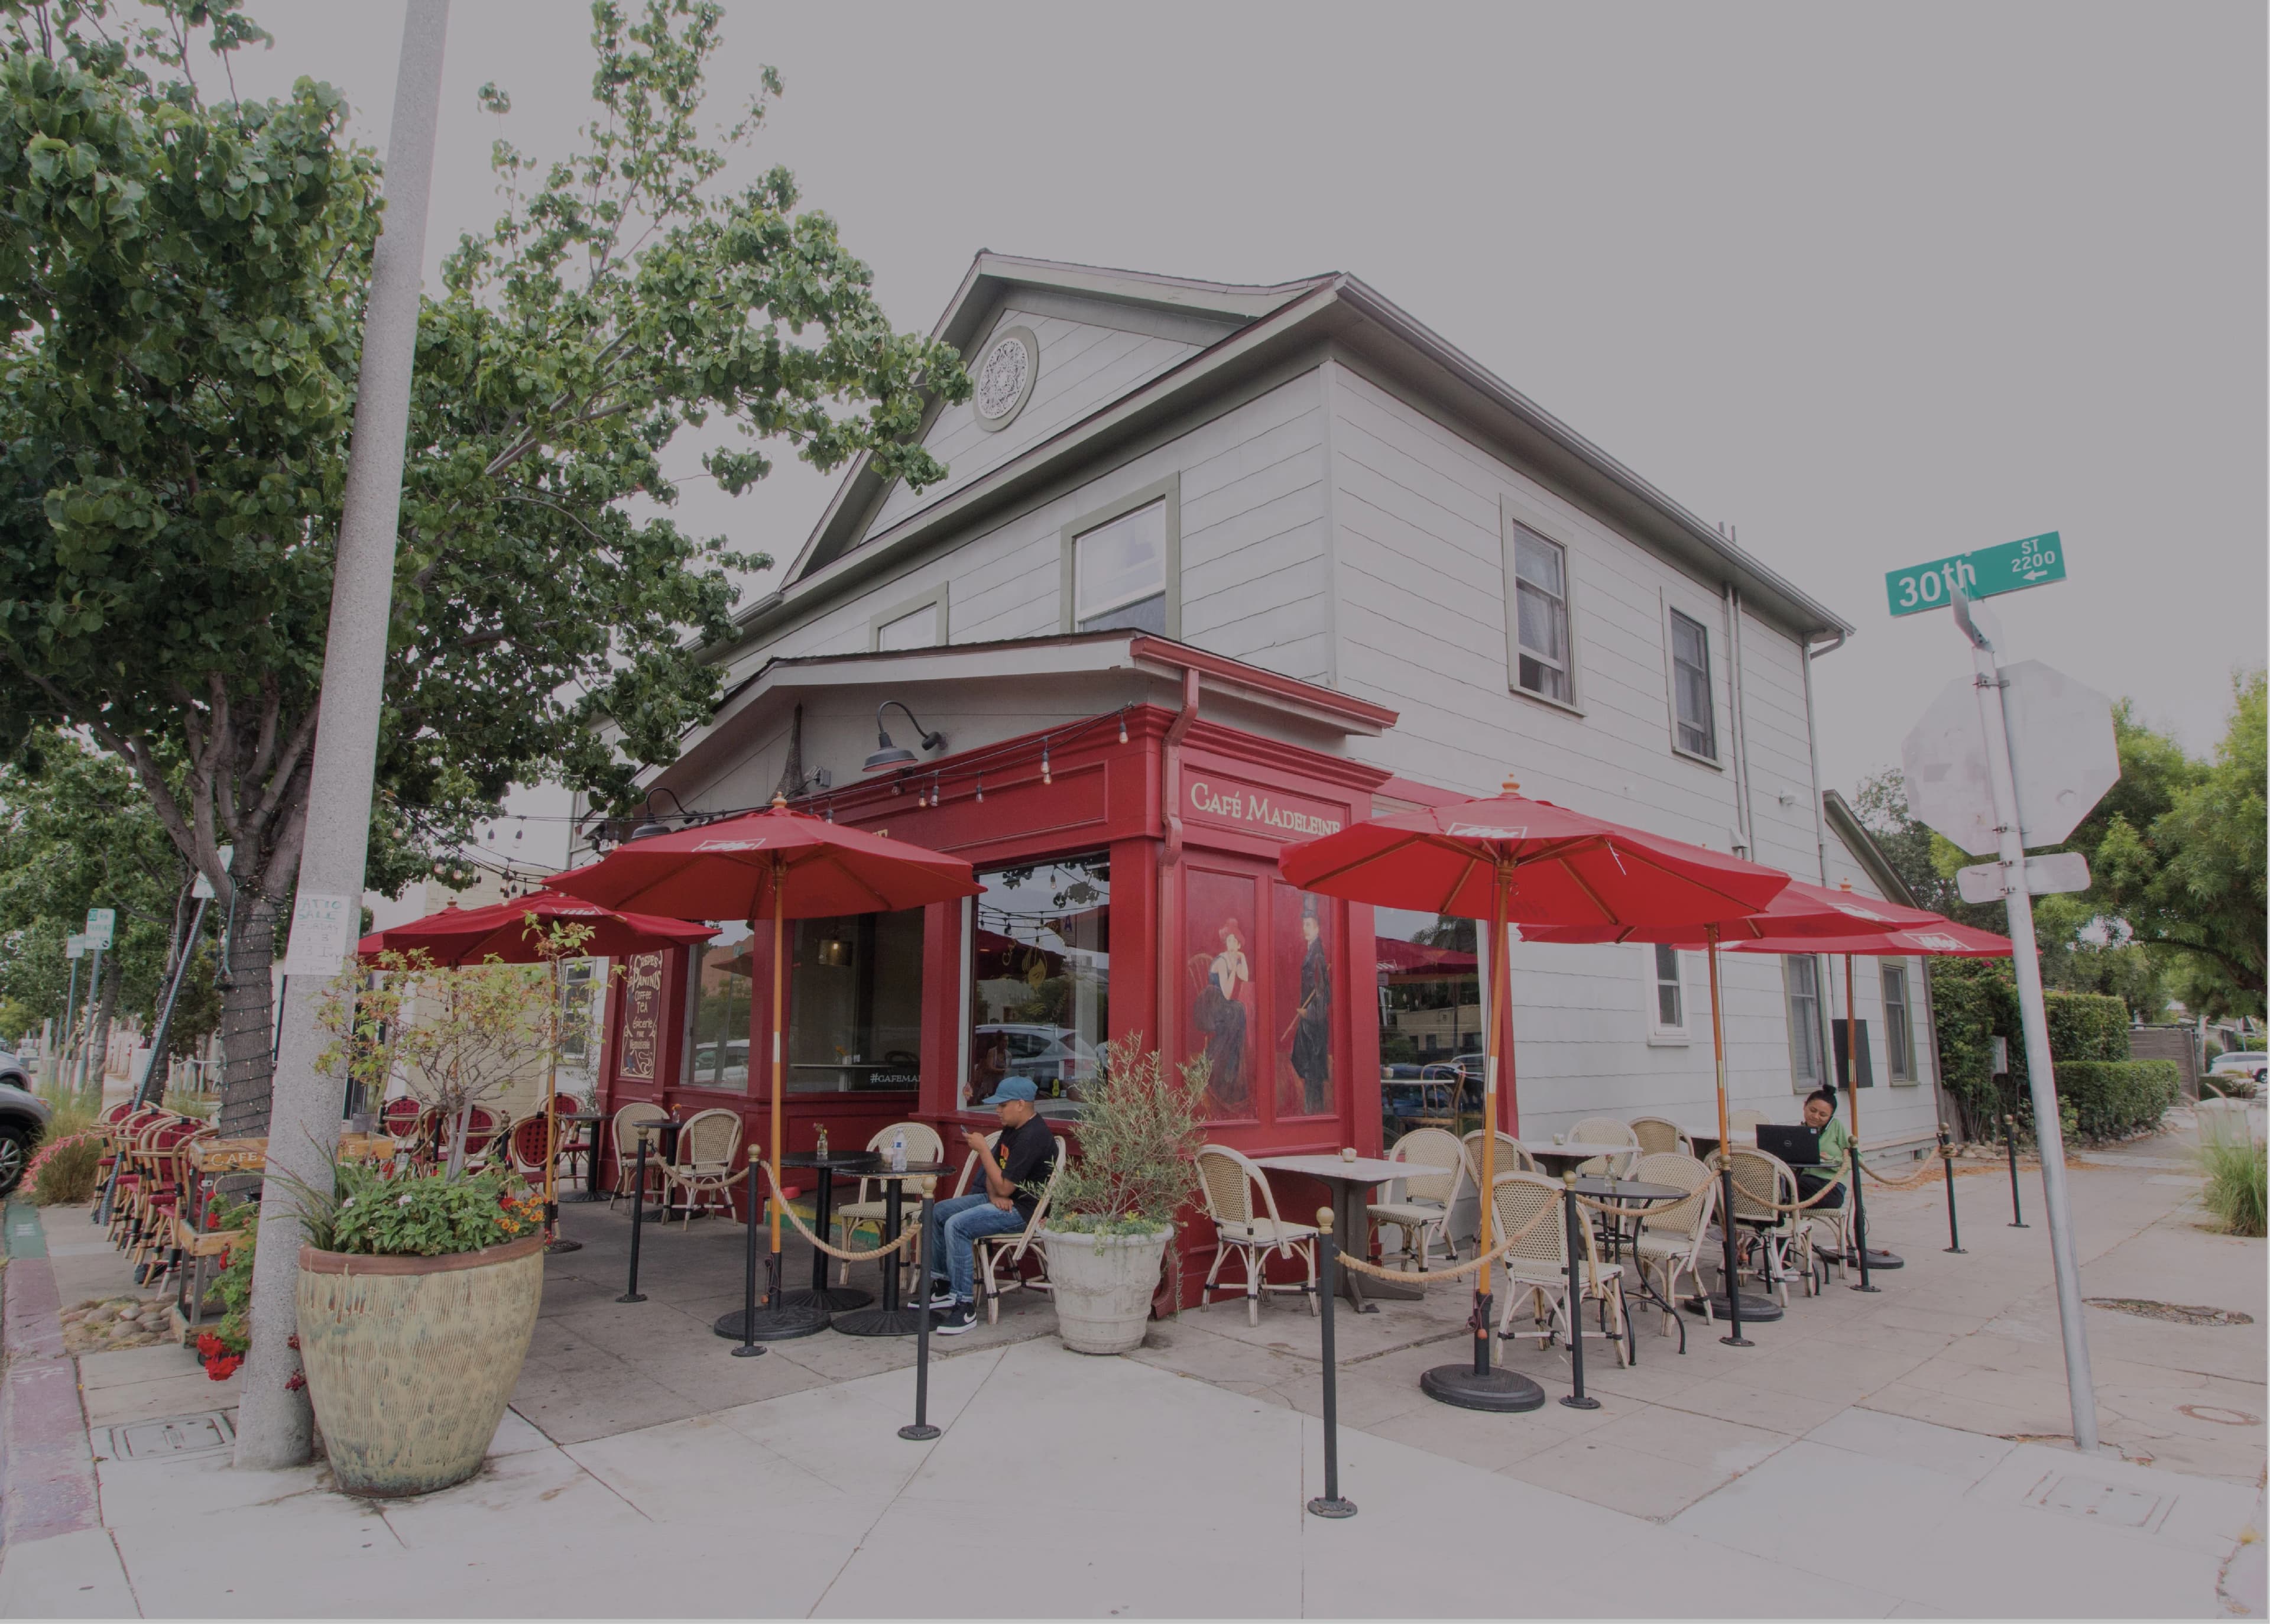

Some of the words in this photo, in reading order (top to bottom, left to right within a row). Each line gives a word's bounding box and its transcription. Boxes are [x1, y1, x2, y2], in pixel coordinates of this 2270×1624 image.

[2022, 539, 2039, 554] ST
[2012, 550, 2056, 573] 2200
[1899, 559, 1976, 607] 30th
[1191, 782, 1241, 819] CAFÉ
[1246, 795, 1341, 836] MADELEINE
[633, 967, 661, 993] PANINIS
[870, 1072, 921, 1084] #CAFEMA
[211, 1152, 258, 1166] CAFE
